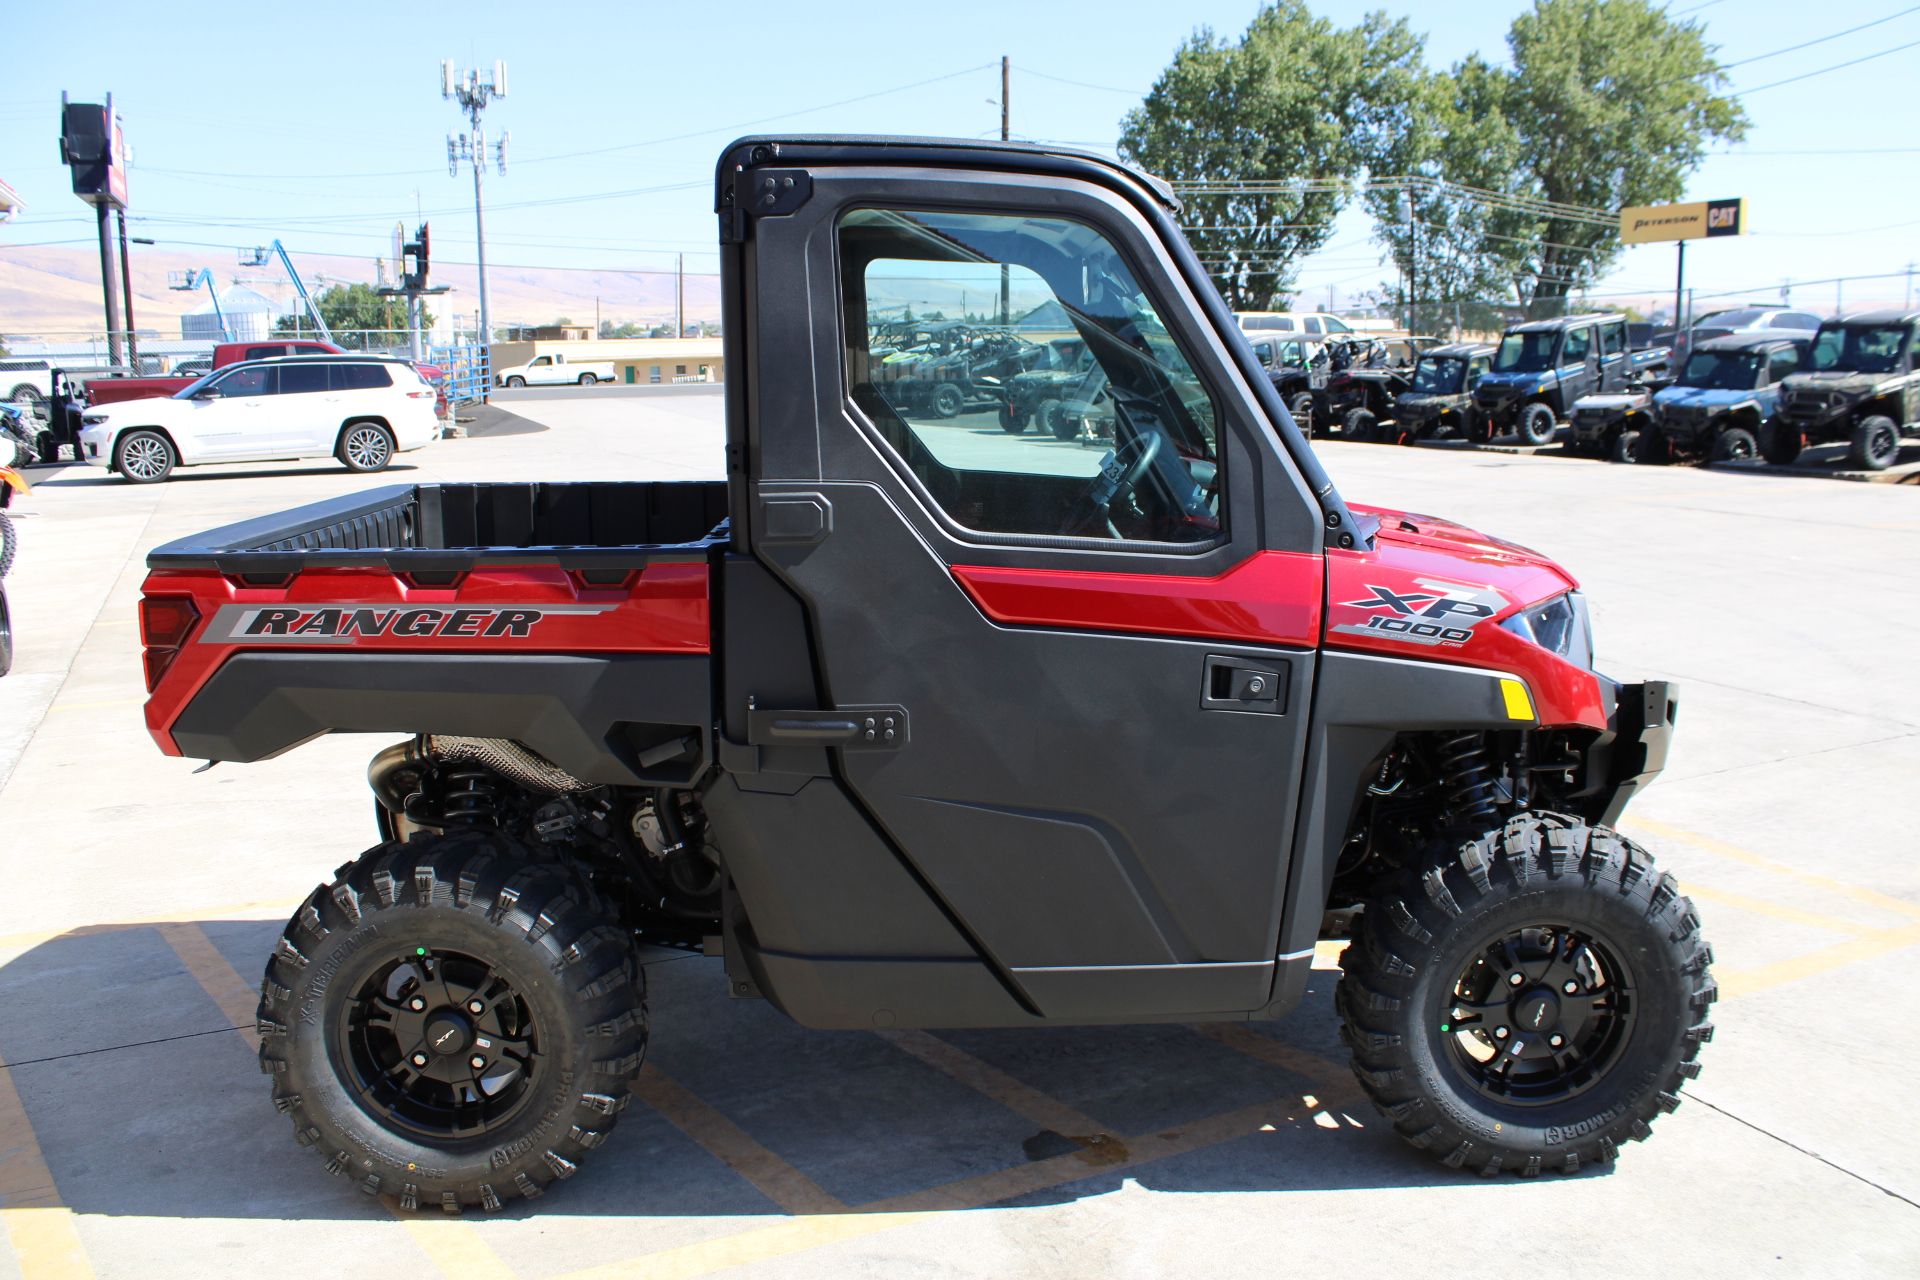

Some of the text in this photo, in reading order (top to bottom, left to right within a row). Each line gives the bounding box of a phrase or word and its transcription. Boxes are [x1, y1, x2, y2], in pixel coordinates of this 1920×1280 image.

[1633, 206, 1737, 231] PETERSON CAT
[1338, 584, 1497, 620] XP
[243, 607, 542, 638] RANGER
[1367, 615, 1474, 643] 1000
[1562, 1103, 1626, 1140] ARMOR
